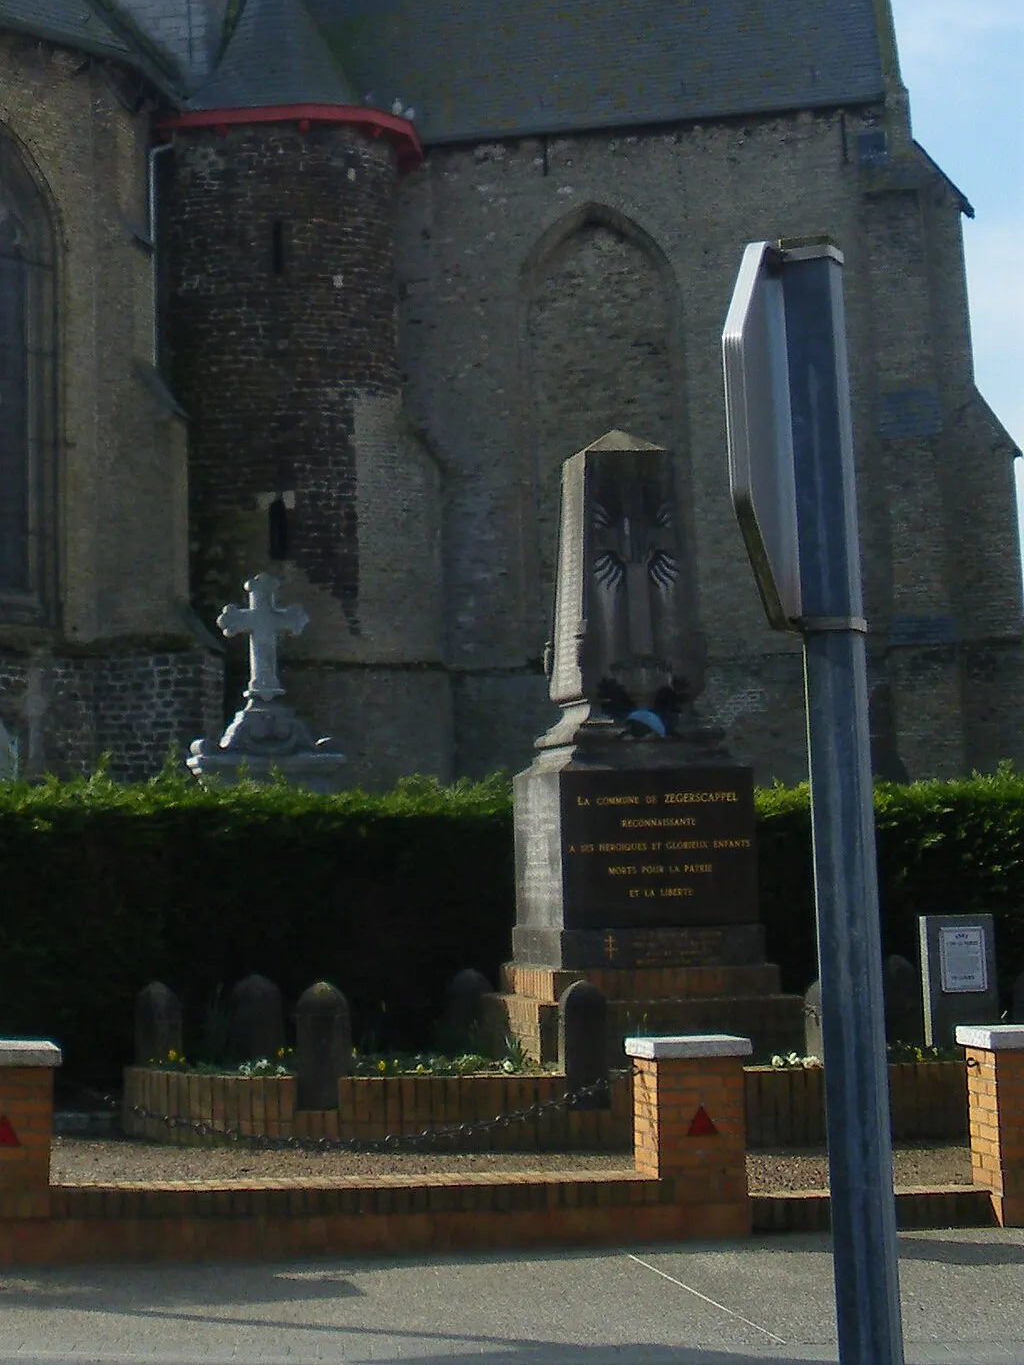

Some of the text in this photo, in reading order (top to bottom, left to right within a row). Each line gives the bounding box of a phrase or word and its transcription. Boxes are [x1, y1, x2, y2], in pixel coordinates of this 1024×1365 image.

[651, 841, 662, 851] ET
[713, 838, 752, 849] ENFANTS
[607, 862, 713, 875] MORTS POUR LA PATRIE
[628, 888, 640, 899] ET
[643, 888, 656, 898] LA
